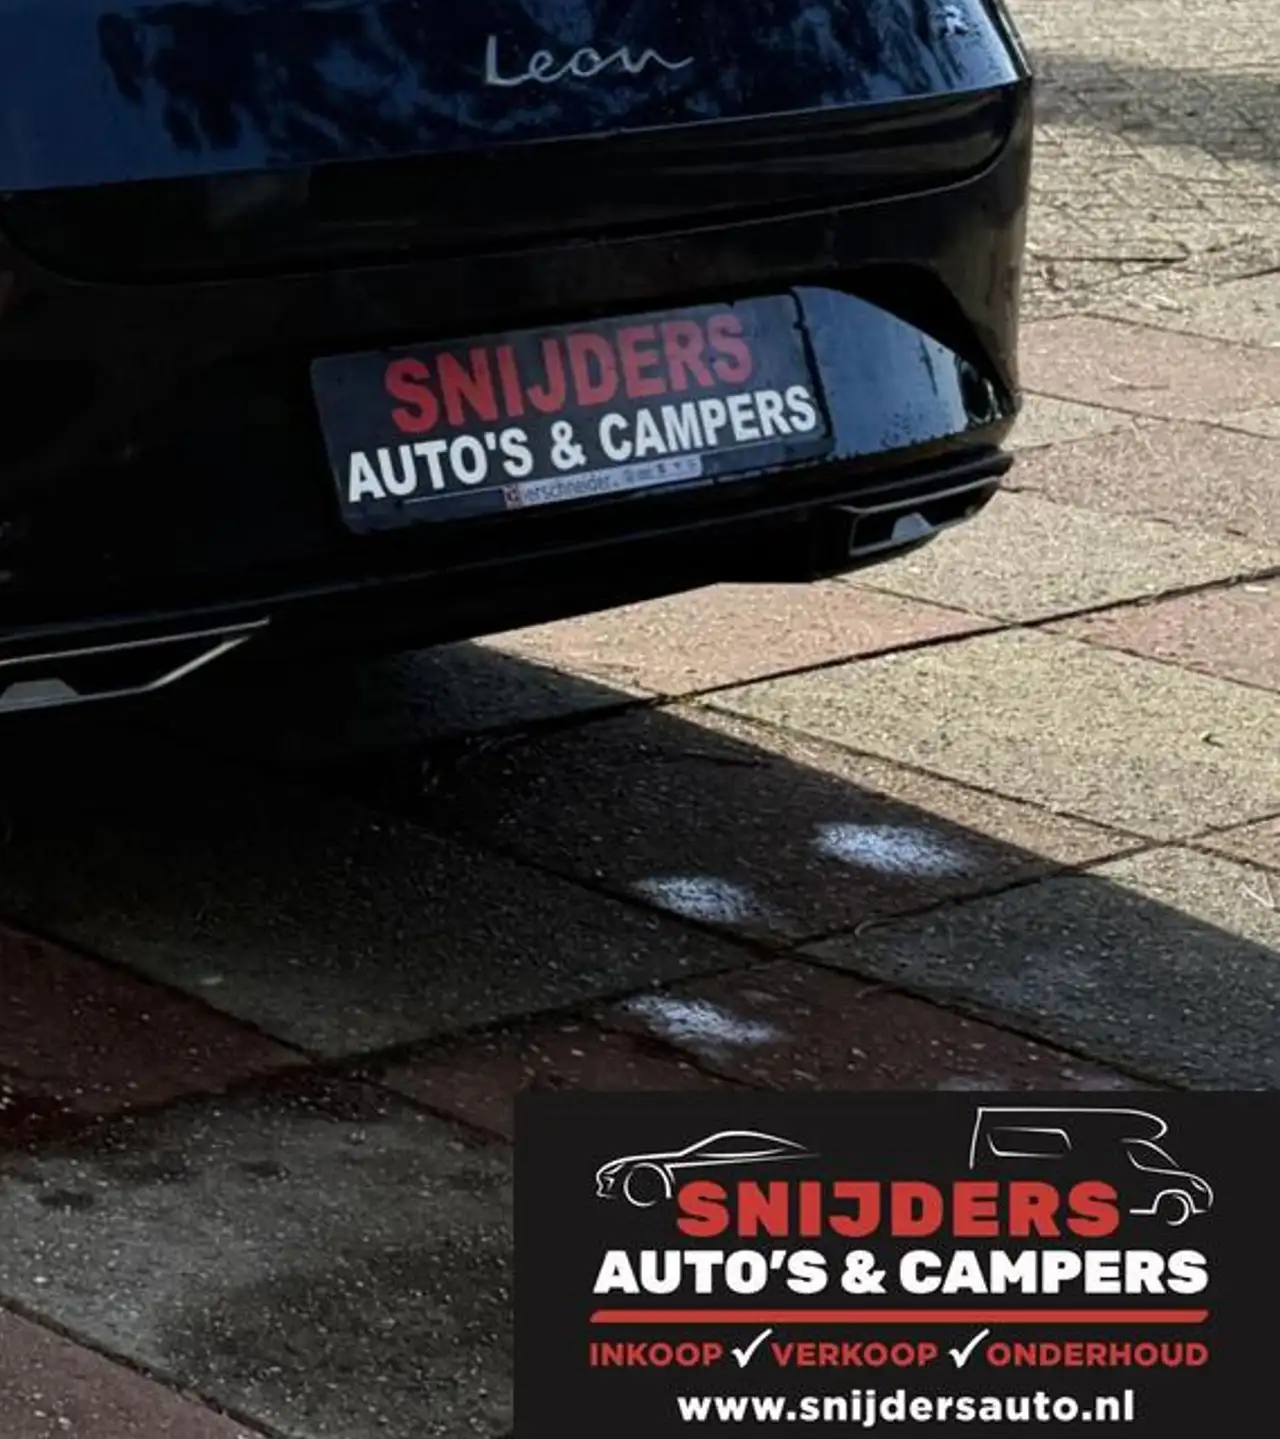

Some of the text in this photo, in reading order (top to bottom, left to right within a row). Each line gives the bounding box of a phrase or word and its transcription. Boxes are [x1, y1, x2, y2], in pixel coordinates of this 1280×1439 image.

[486, 35, 694, 86] Leon
[384, 314, 753, 433] SNIJDERS
[347, 385, 817, 503] AUTO'S & CAMPERS
